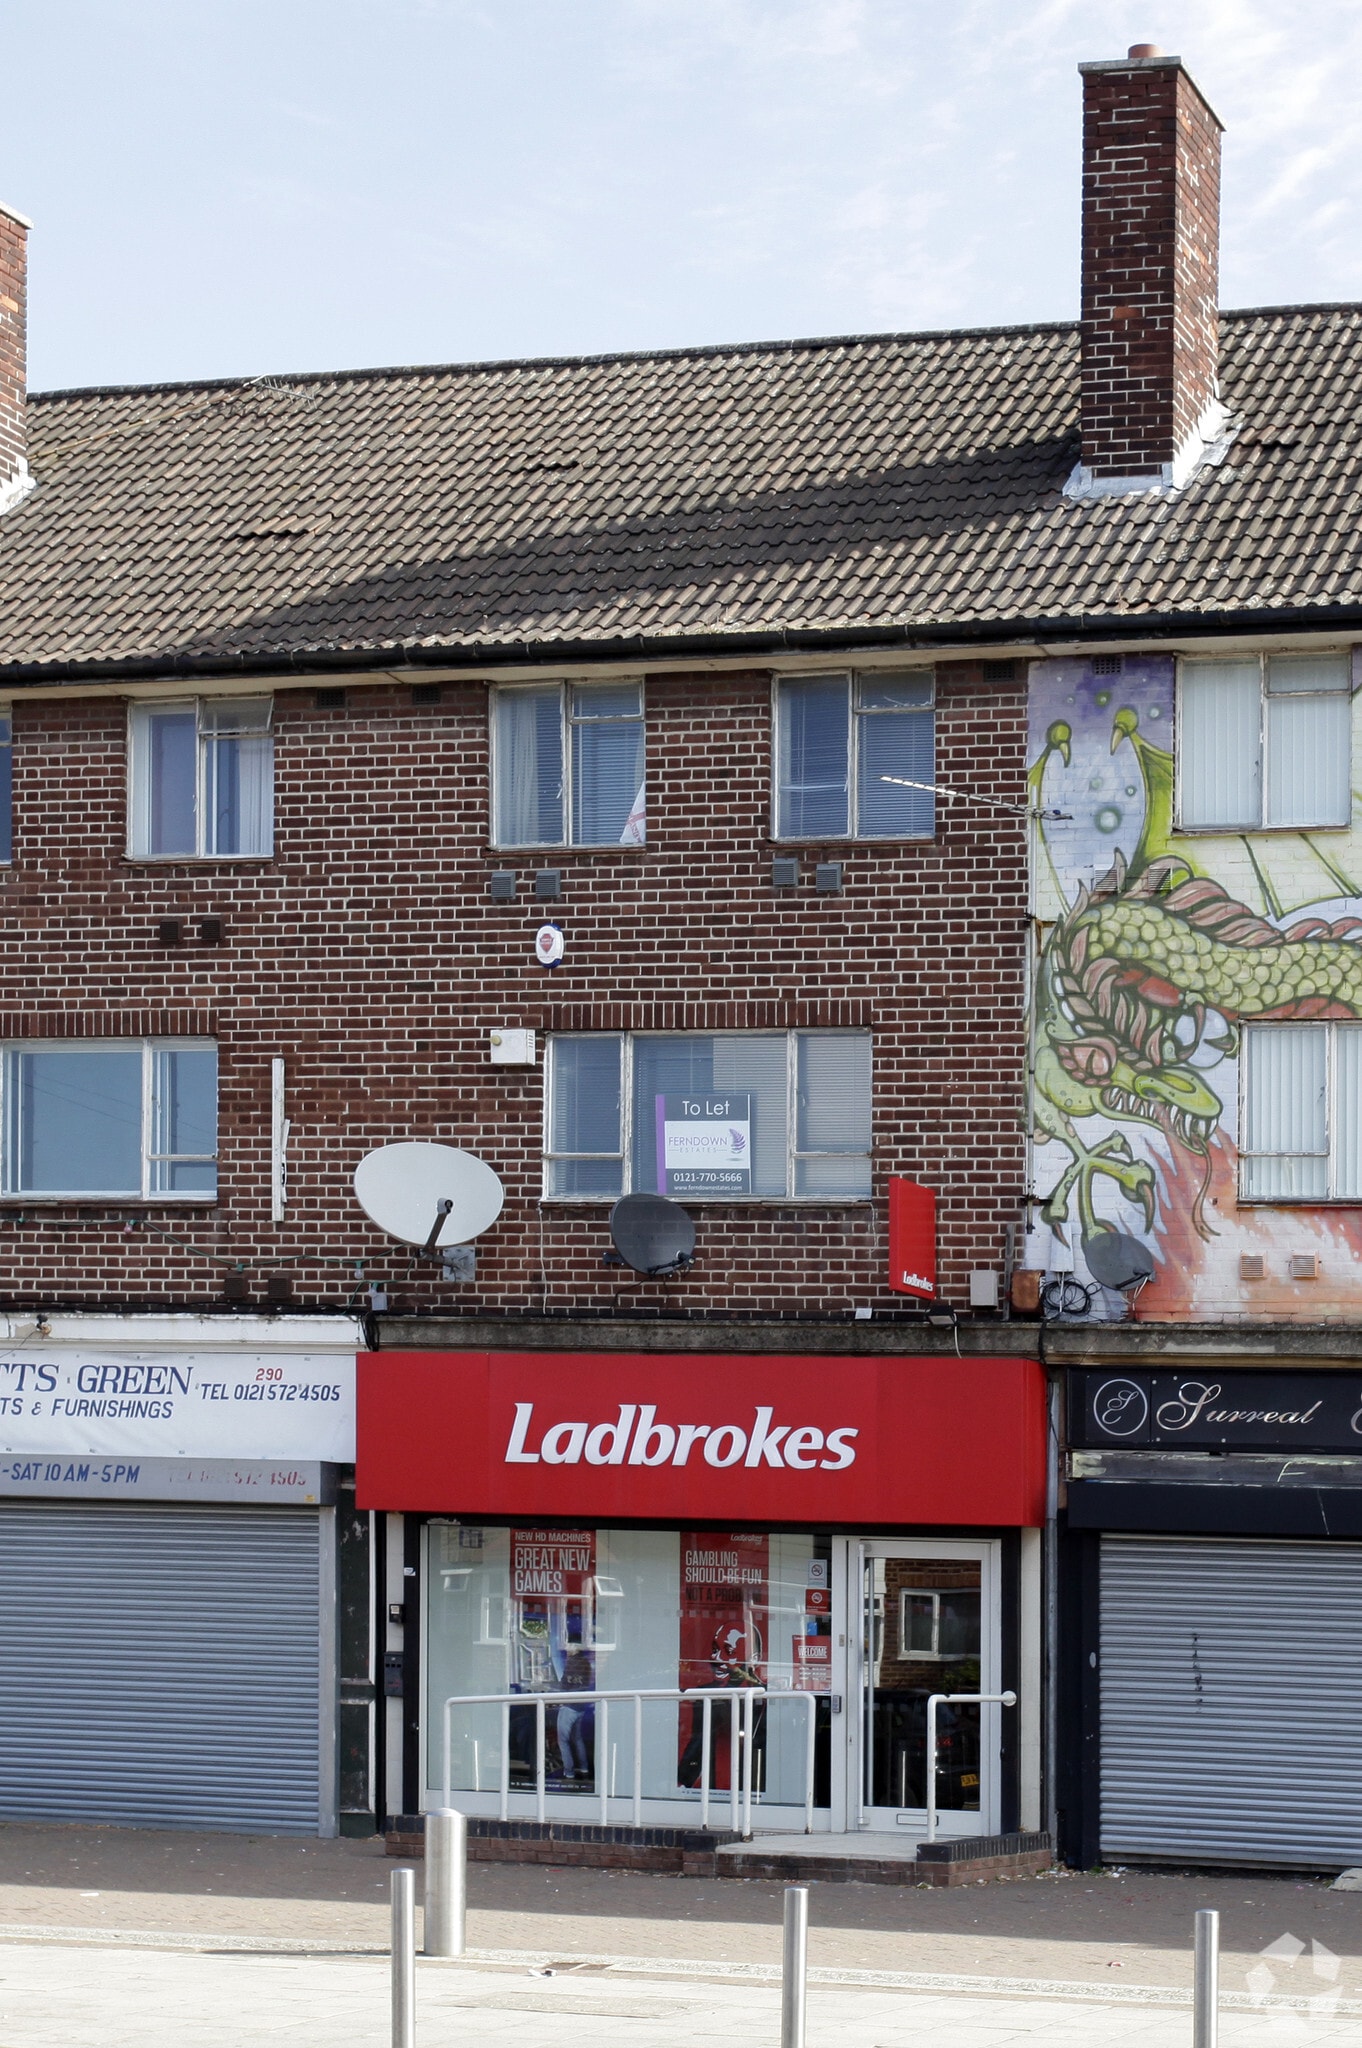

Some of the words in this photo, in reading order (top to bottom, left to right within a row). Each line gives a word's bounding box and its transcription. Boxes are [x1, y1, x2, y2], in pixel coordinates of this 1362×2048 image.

[682, 1100, 701, 1116] To
[706, 1100, 730, 1116] Let
[668, 1137, 728, 1147] FERNDOWN
[673, 1172, 742, 1183] 0121-770-5666
[76, 1364, 195, 1395] GREEN
[255, 1367, 283, 1381] 290
[201, 1383, 230, 1400] TEL
[31, 1401, 42, 1416] &
[51, 1398, 174, 1419] FURNISHINGS
[1155, 1381, 1323, 1432] Surreal
[504, 1402, 859, 1471] Ladbrokes
[515, 1532, 533, 1541] NEW
[535, 1532, 546, 1542] HD
[549, 1533, 591, 1543] MACHINES
[515, 1547, 556, 1570] GREAT
[558, 1549, 590, 1571] NEW
[685, 1550, 738, 1567] GAMBLING
[515, 1570, 562, 1593] GAMES
[685, 1566, 725, 1584] SHOULD
[727, 1568, 740, 1584] BE
[741, 1568, 762, 1585] FUN
[685, 1586, 704, 1601] NOT
[706, 1587, 713, 1601] A
[798, 1646, 827, 1657] WELCOME
